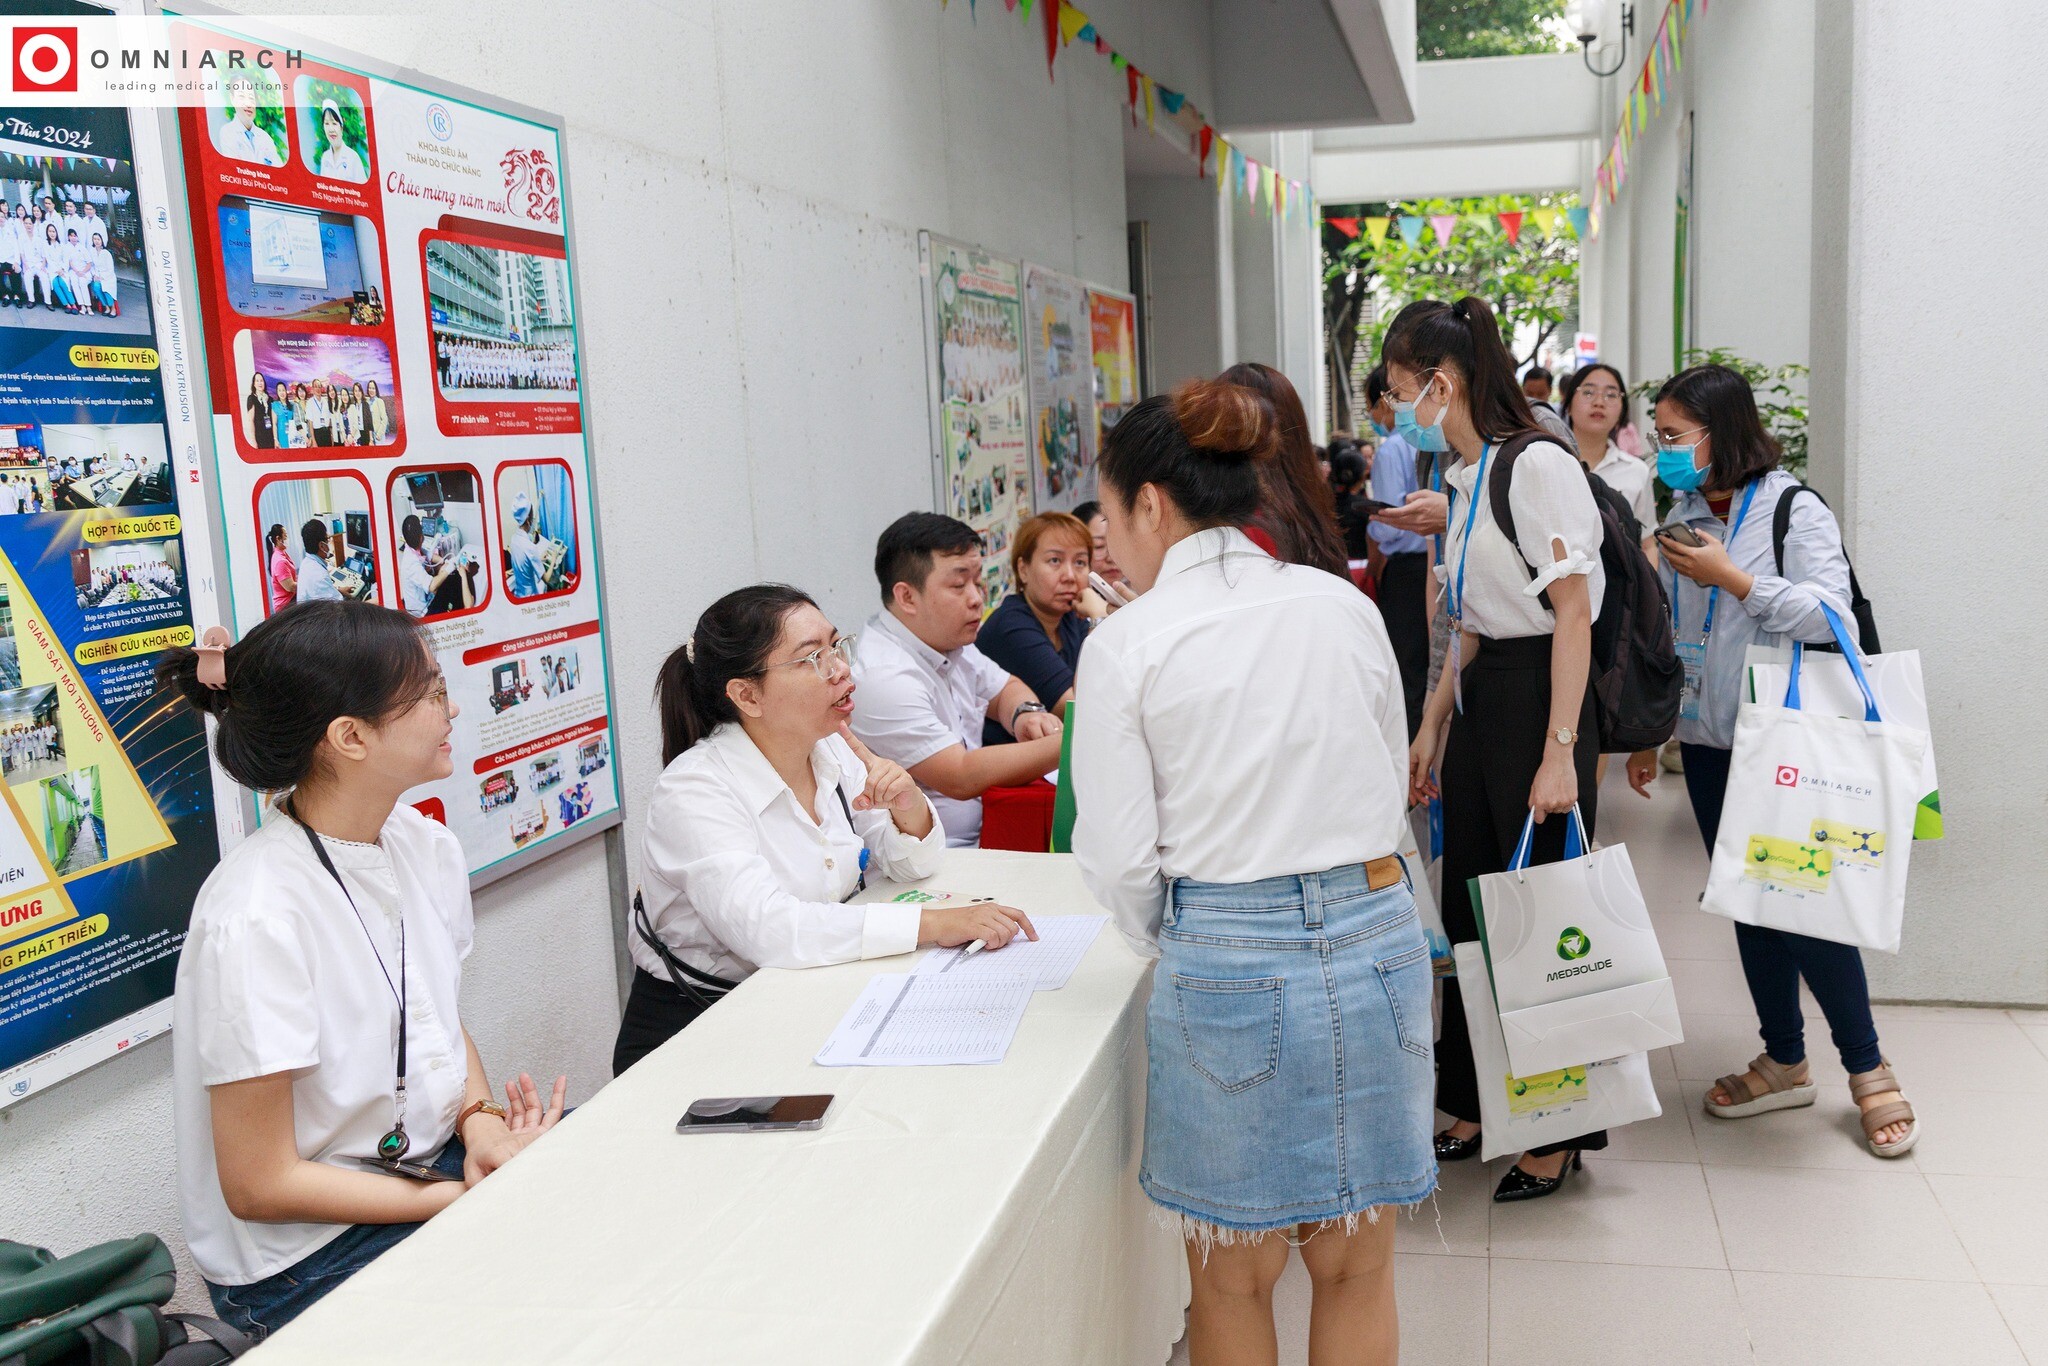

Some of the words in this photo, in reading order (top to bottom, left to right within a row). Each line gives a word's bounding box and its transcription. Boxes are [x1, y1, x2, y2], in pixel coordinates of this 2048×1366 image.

[5, 117, 40, 138] Thìn
[42, 126, 93, 148] 2024
[418, 140, 439, 154] KHOA
[386, 171, 420, 196] Chúc
[75, 347, 93, 362] CHỈ
[96, 352, 118, 365] ĐẠO
[120, 350, 155, 364] TUYẾN
[175, 363, 189, 422] EXTRUSION
[451, 415, 459, 423] 77
[87, 525, 108, 539] HỢP
[110, 522, 130, 535] TÁC
[133, 519, 161, 533] QUỐC
[163, 515, 176, 530] TẾ
[80, 642, 118, 660] NGHIÊN
[120, 638, 140, 652] CỨU
[142, 635, 168, 648] KHOA
[171, 630, 190, 643] HỌC
[27, 619, 49, 650] GIÁM
[46, 650, 64, 672] SÁT
[61, 674, 77, 697] MÔI
[75, 695, 104, 743] TRƯỜNG
[1801, 776, 1871, 796] OMNIARCH
[0, 900, 43, 927] ƯNG
[18, 939, 54, 962] PHÁT
[58, 921, 97, 945] TRIỂN
[1546, 959, 1612, 982] MEDBOLIDE
